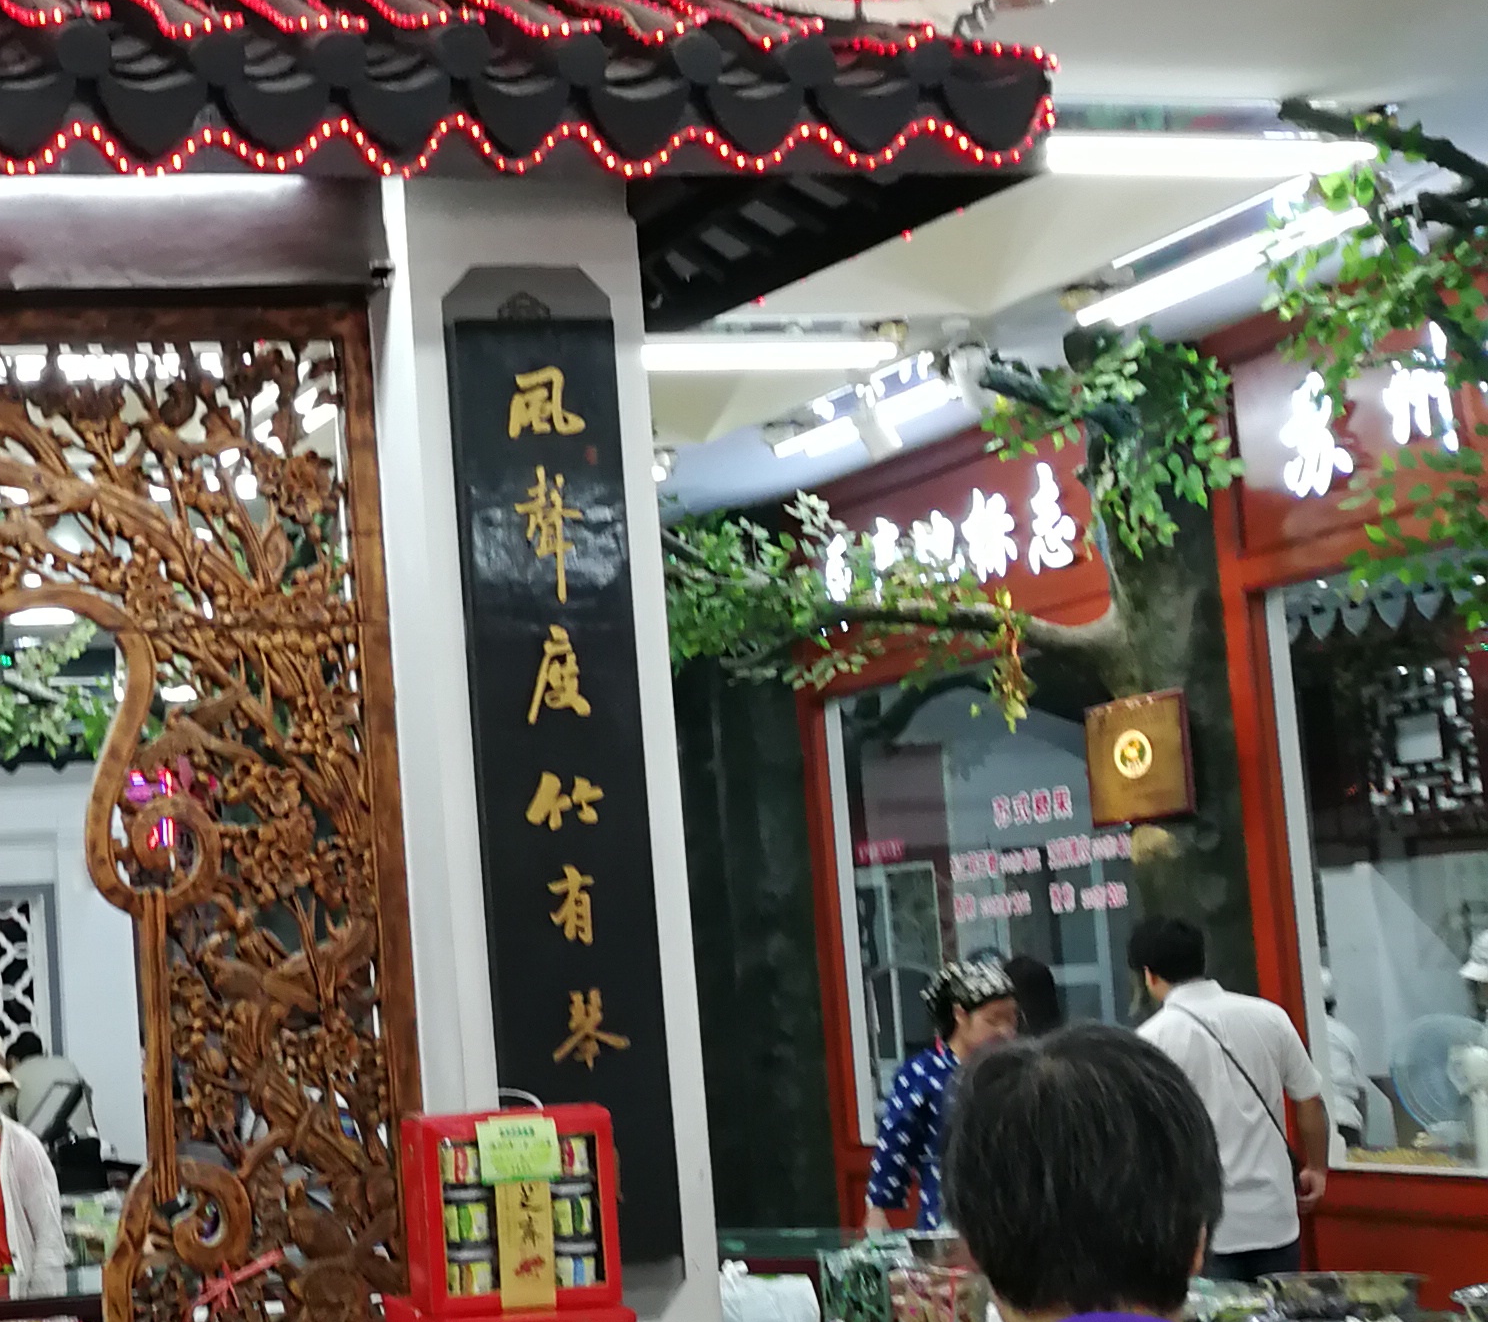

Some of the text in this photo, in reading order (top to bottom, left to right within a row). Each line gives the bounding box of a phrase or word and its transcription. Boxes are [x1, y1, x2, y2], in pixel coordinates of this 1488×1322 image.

[507, 365, 633, 1071] 風聲度竹有琴
